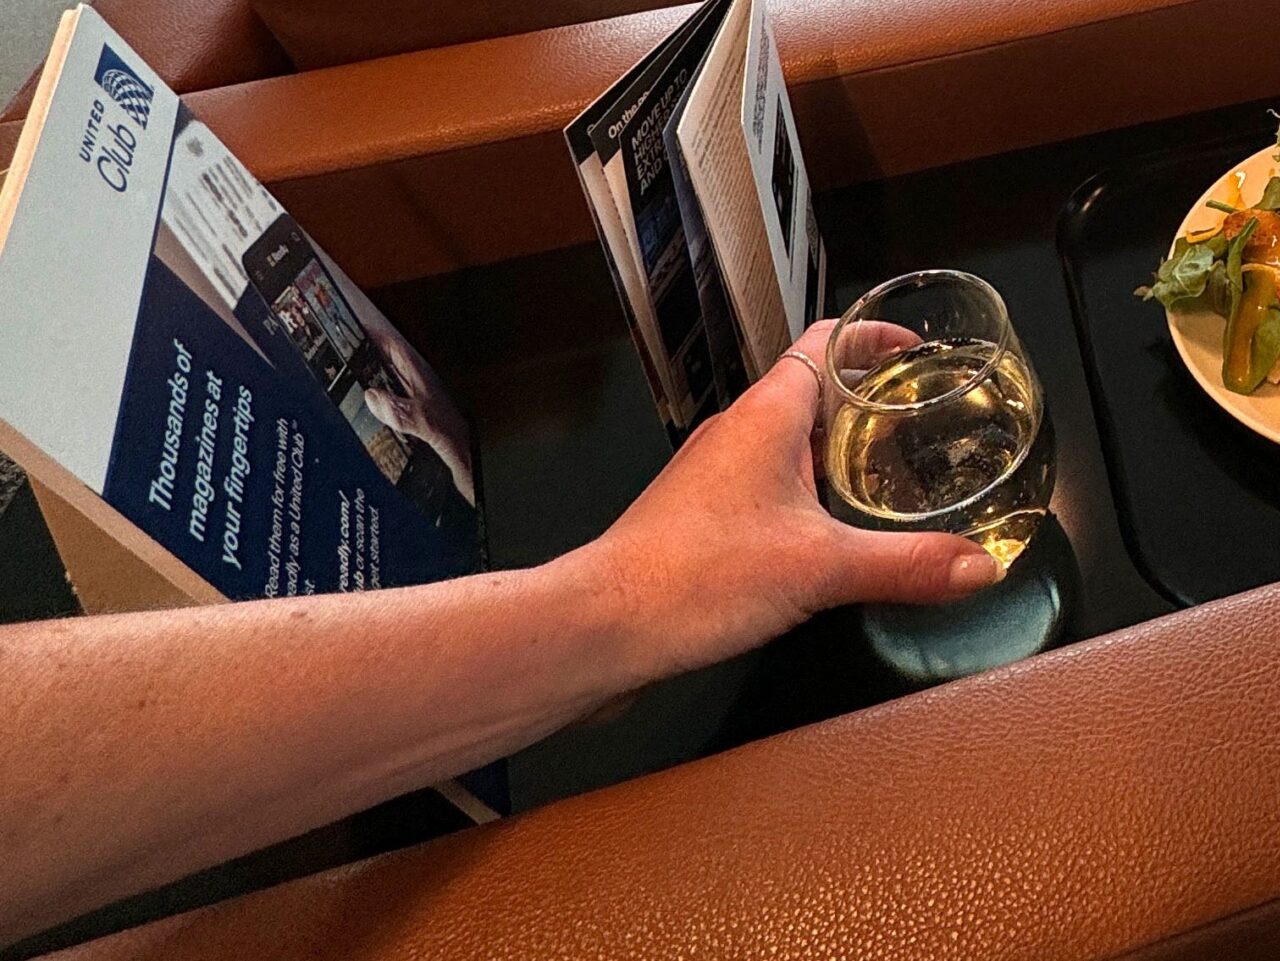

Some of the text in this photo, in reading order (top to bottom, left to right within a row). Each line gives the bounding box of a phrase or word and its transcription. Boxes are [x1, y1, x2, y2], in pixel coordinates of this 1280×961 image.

[79, 99, 105, 163] UNITED
[608, 122, 623, 139] On
[632, 102, 663, 150] MOVE
[659, 86, 674, 109] UP
[673, 68, 688, 89] TO
[97, 124, 137, 192] Club
[640, 158, 663, 196] AND
[149, 338, 193, 511] Thousands of
[189, 370, 223, 542] magazines at
[222, 385, 255, 570] your fingertips
[265, 418, 288, 598] Read them for free with
[288, 466, 303, 521] United
[354, 488, 365, 514] the
[289, 534, 300, 556] as
[290, 521, 300, 535] a
[356, 514, 365, 552] scan
[356, 551, 365, 570] or
